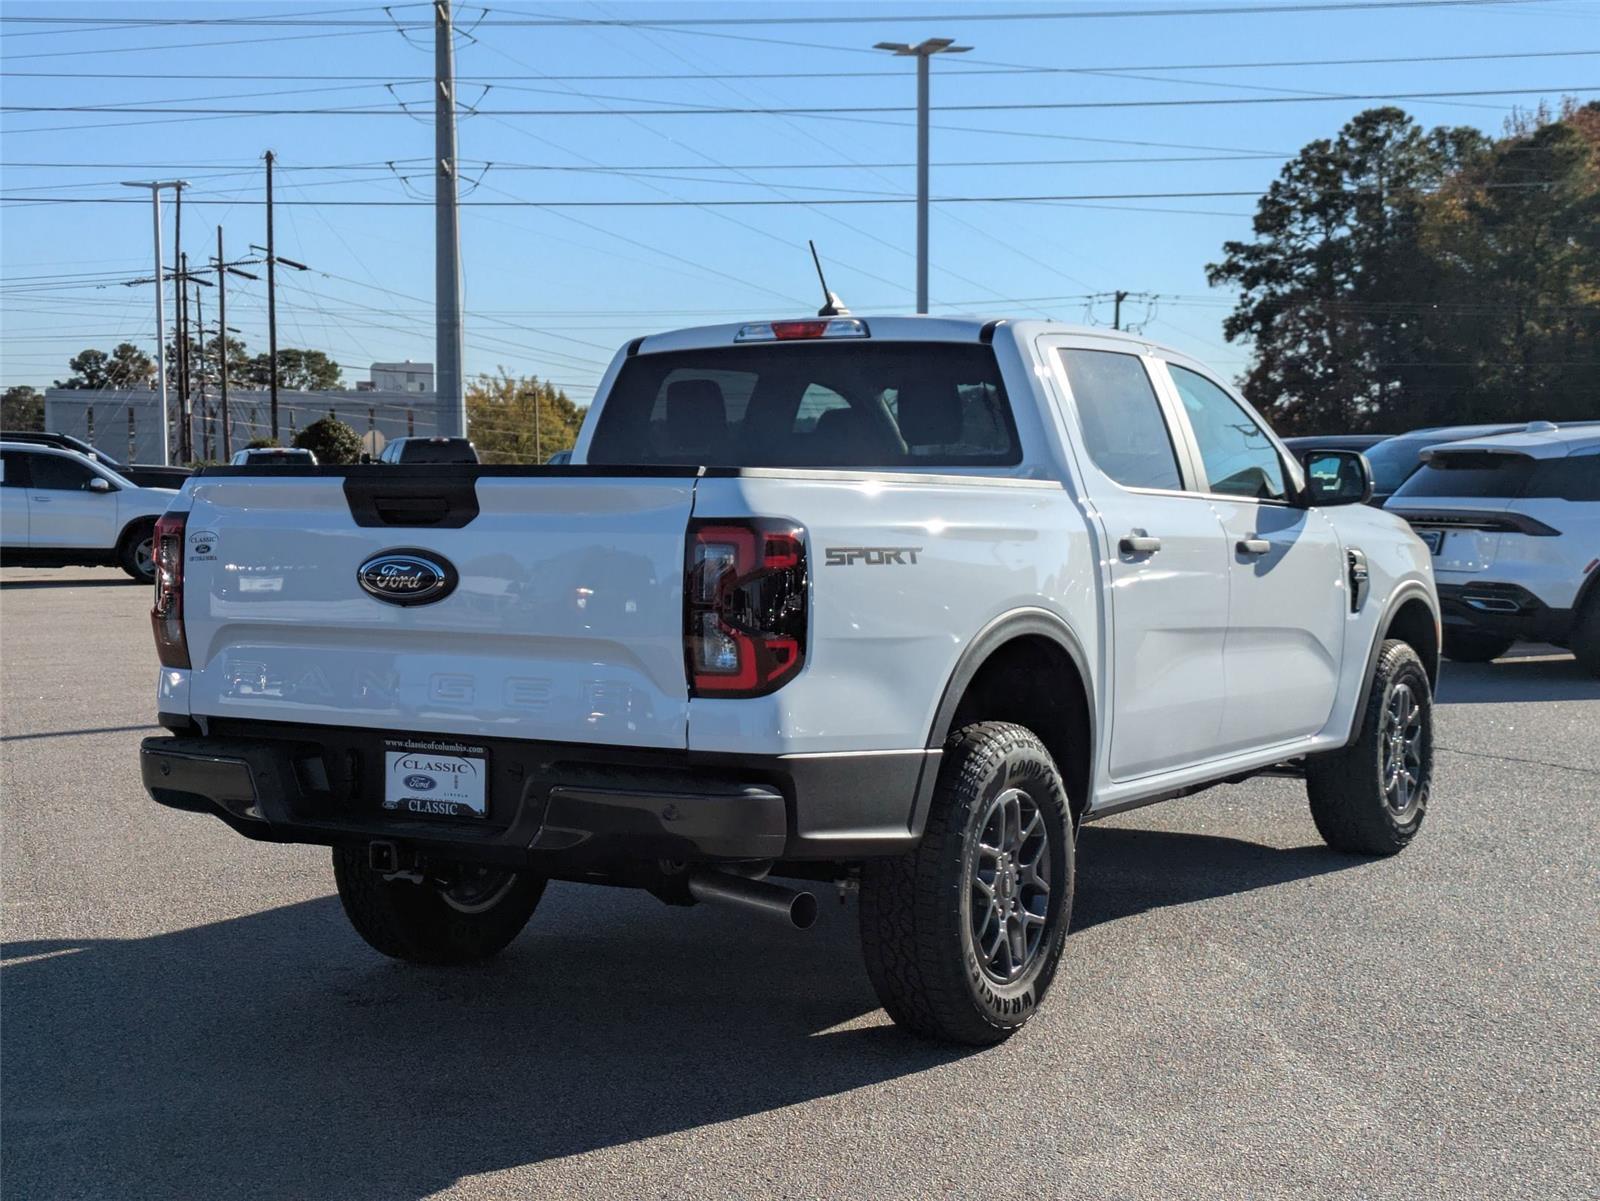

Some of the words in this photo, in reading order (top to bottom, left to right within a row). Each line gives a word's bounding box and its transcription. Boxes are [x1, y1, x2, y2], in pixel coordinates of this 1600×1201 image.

[825, 547, 923, 566] SPORT
[376, 563, 422, 588] Ford
[385, 739, 484, 753] www.classicofcolumbia.com
[403, 760, 468, 774] CLASSIC
[408, 777, 431, 789] Ford
[408, 800, 458, 815] CLASSIC
